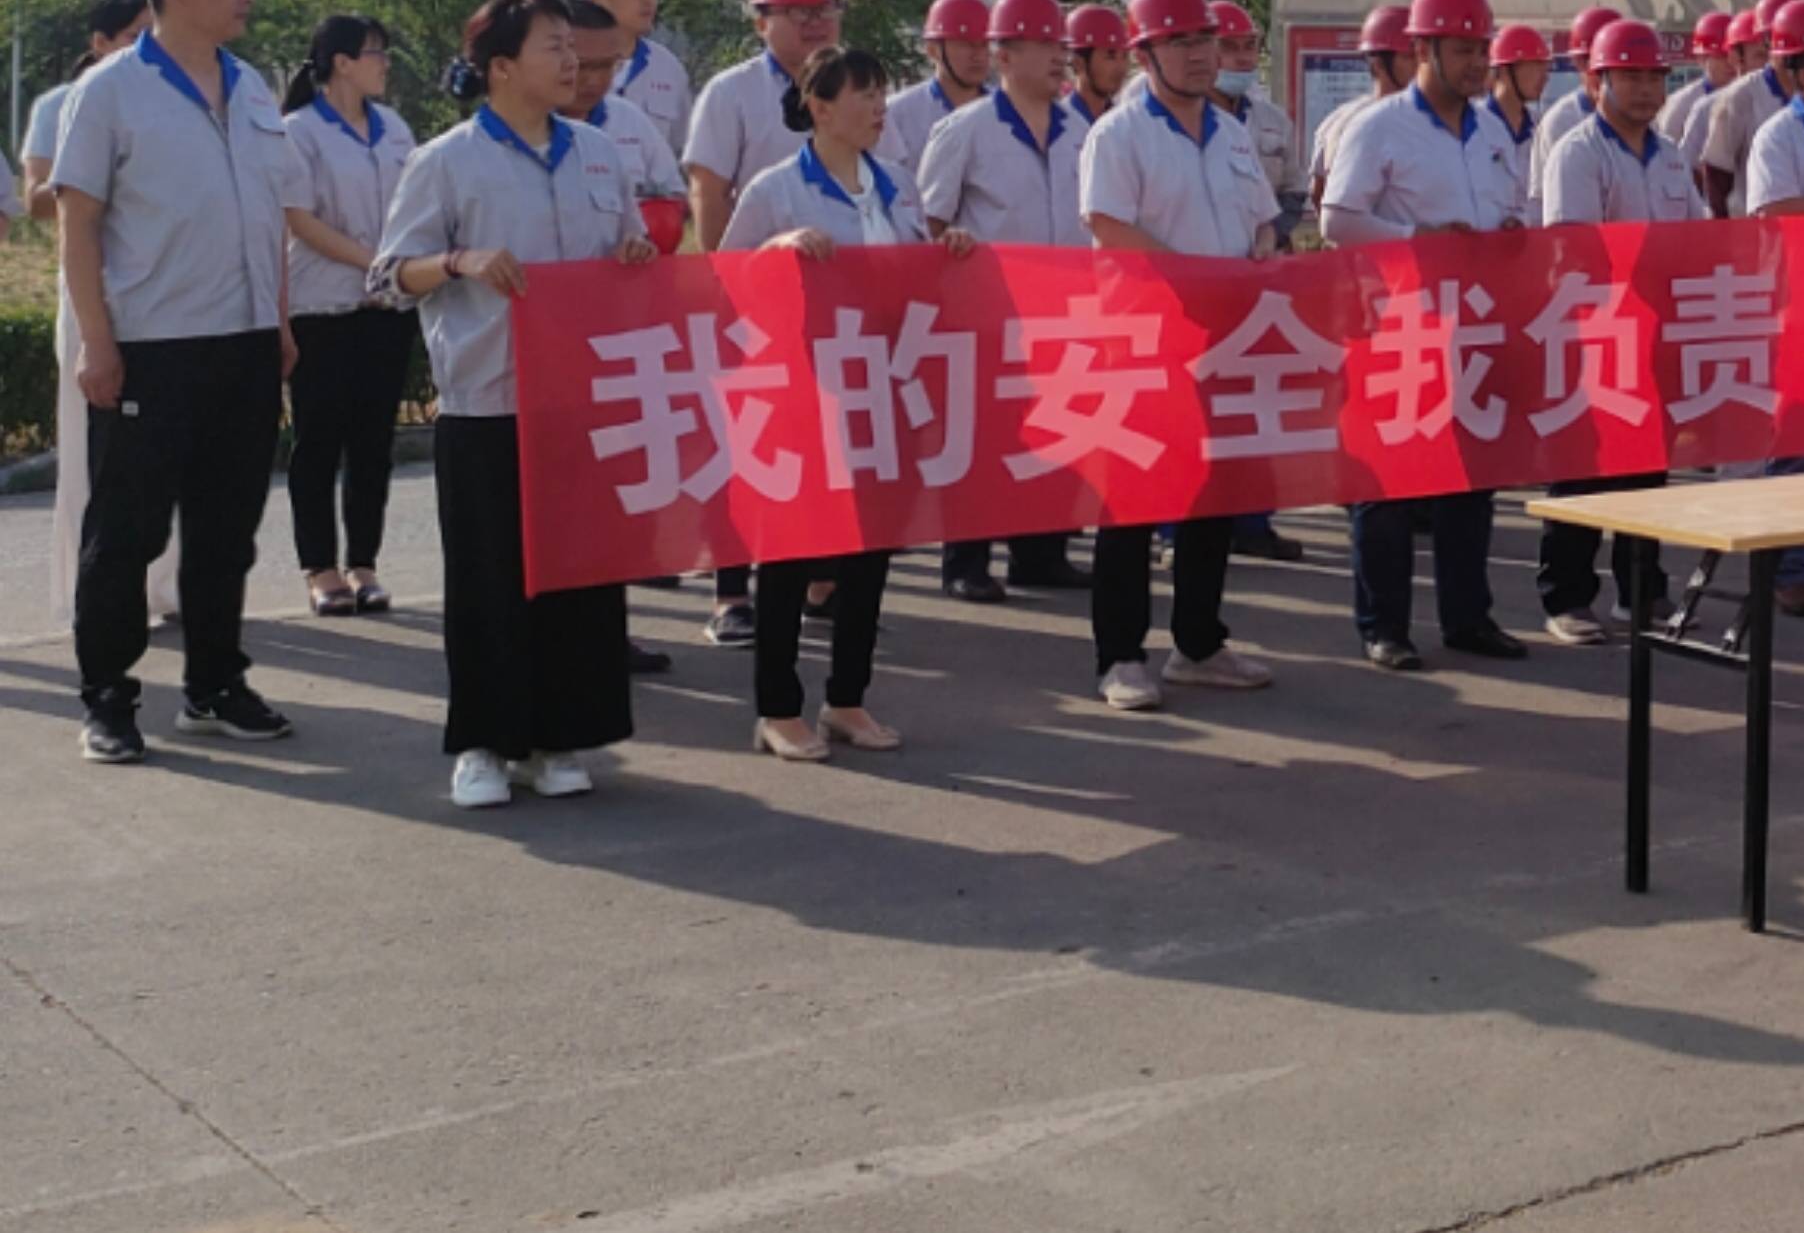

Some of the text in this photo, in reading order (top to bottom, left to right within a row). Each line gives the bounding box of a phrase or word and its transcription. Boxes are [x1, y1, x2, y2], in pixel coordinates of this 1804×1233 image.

[587, 264, 1784, 515] 我的安全我负责
